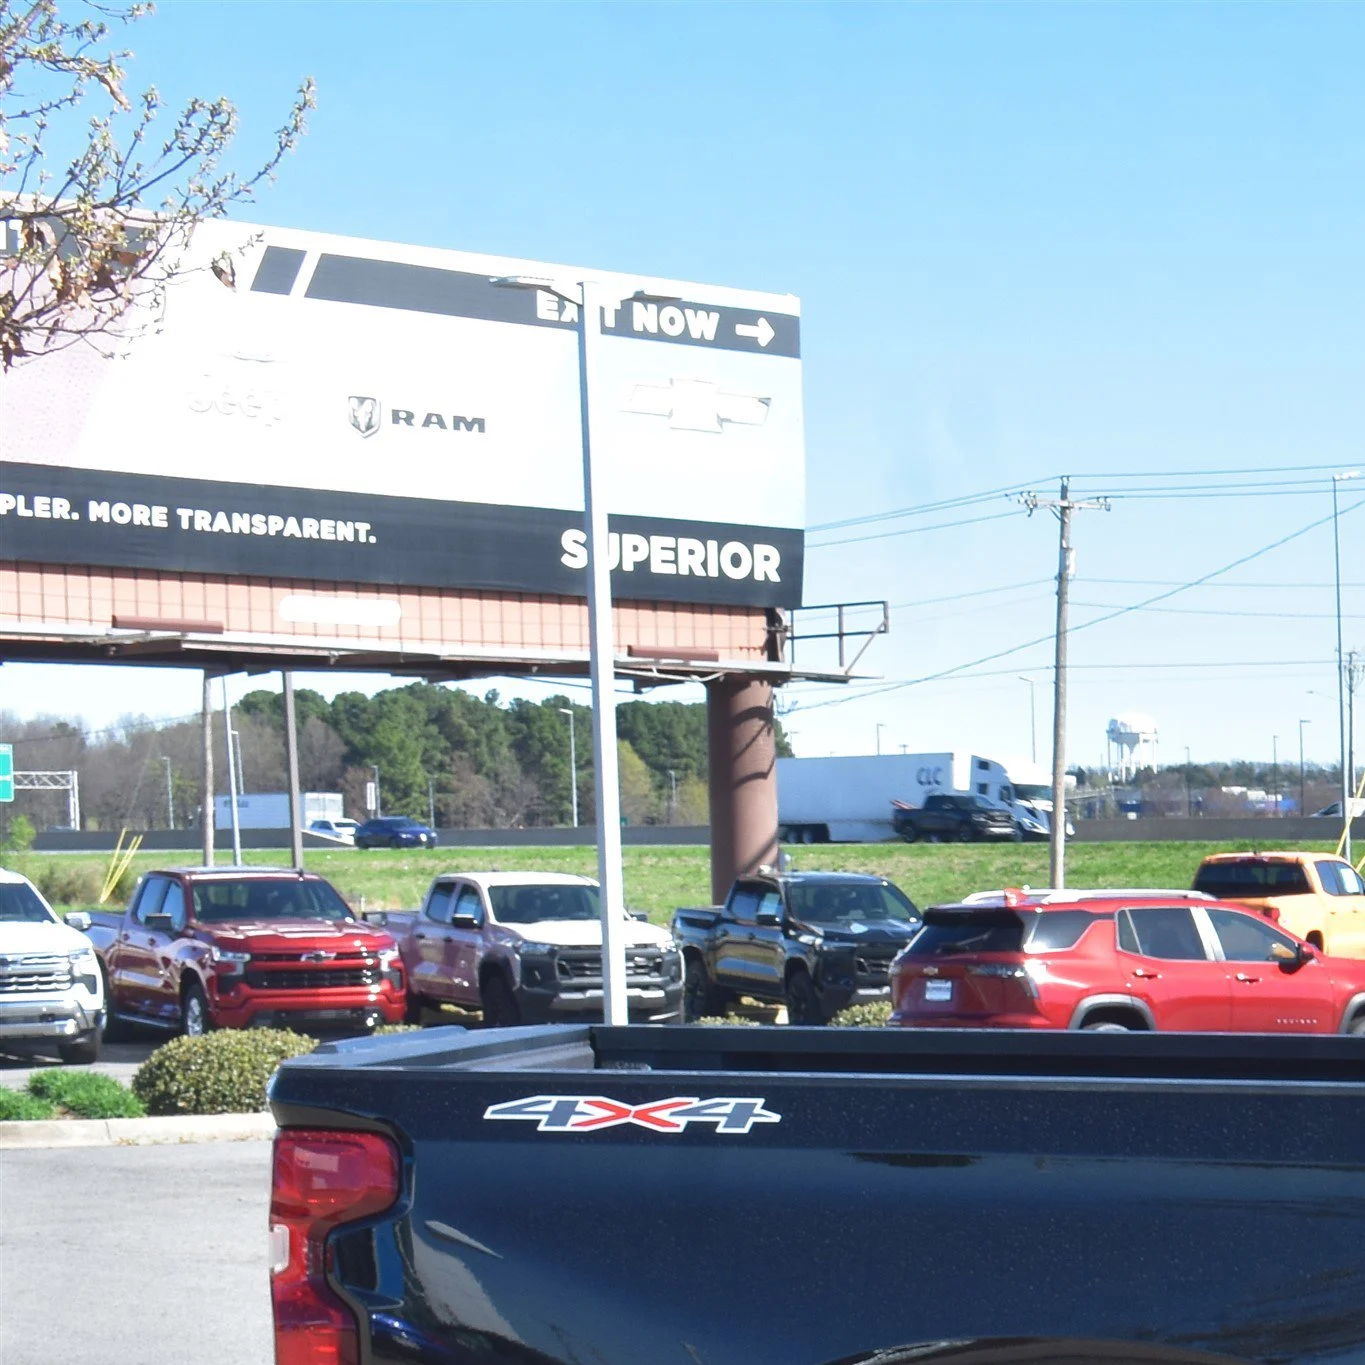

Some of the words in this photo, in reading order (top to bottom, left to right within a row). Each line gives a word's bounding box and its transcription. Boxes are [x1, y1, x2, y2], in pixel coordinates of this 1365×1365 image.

[536, 289, 621, 327] EXT
[632, 302, 720, 341] NOW
[391, 409, 487, 434] RAM
[88, 500, 168, 527] MORE
[176, 508, 377, 544] TRANSPARENT.
